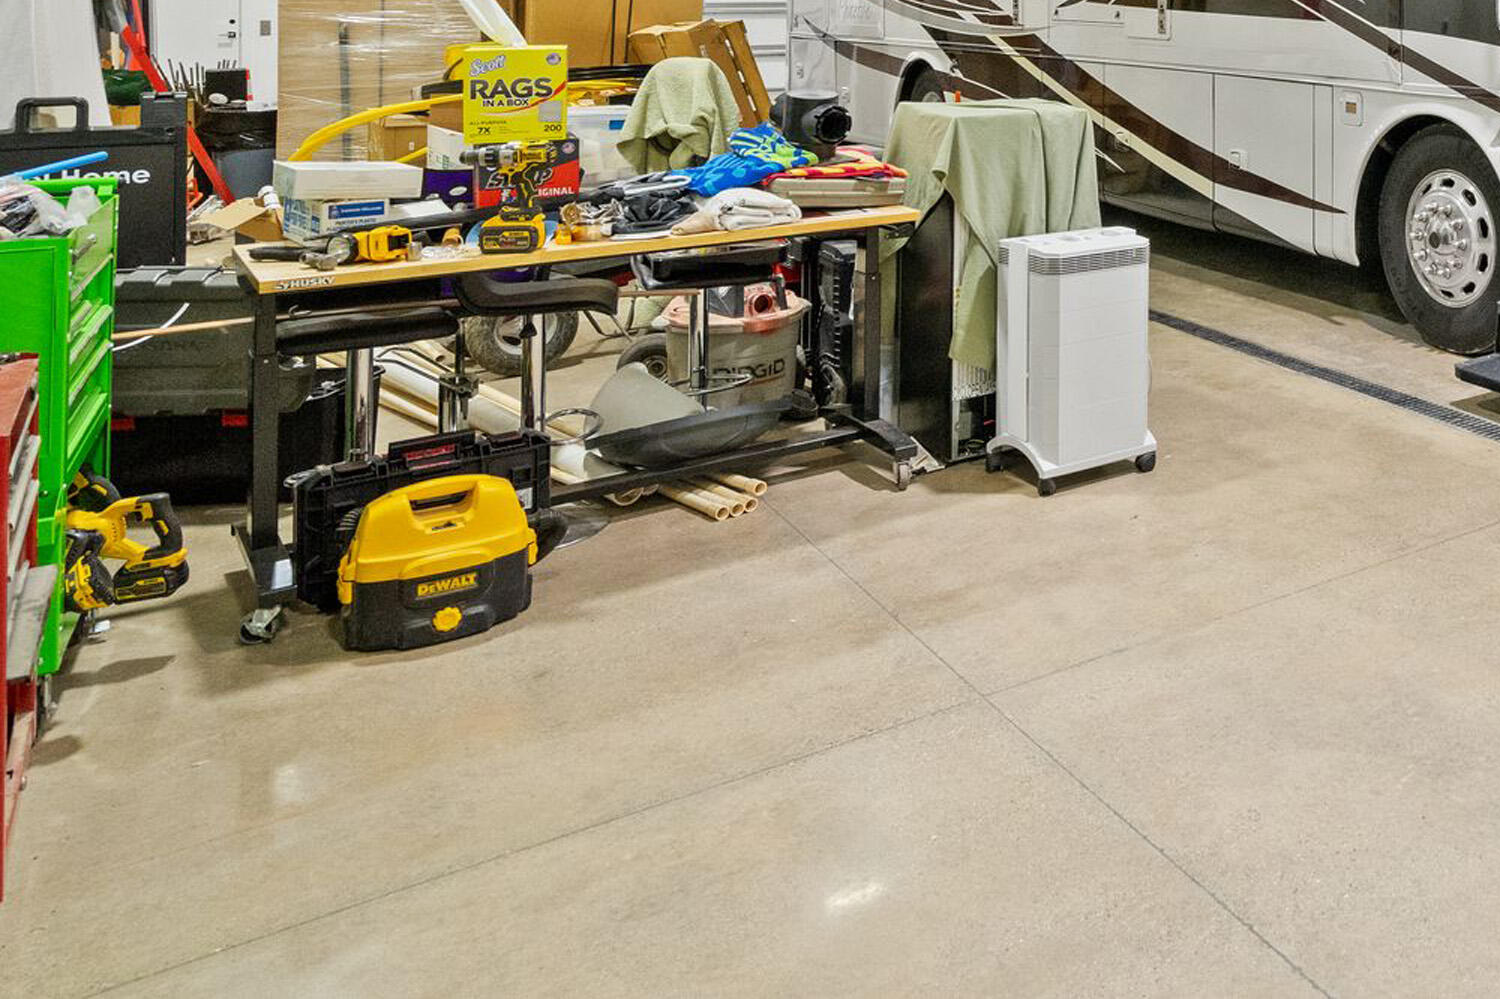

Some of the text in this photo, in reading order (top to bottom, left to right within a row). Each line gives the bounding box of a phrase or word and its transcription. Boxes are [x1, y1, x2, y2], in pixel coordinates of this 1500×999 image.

[469, 55, 505, 77] Scott
[470, 77, 553, 100] RAGS
[507, 98, 529, 106] BOX
[478, 126, 491, 135] 7X
[544, 124, 562, 132] 200
[291, 276, 335, 288] HUSKY
